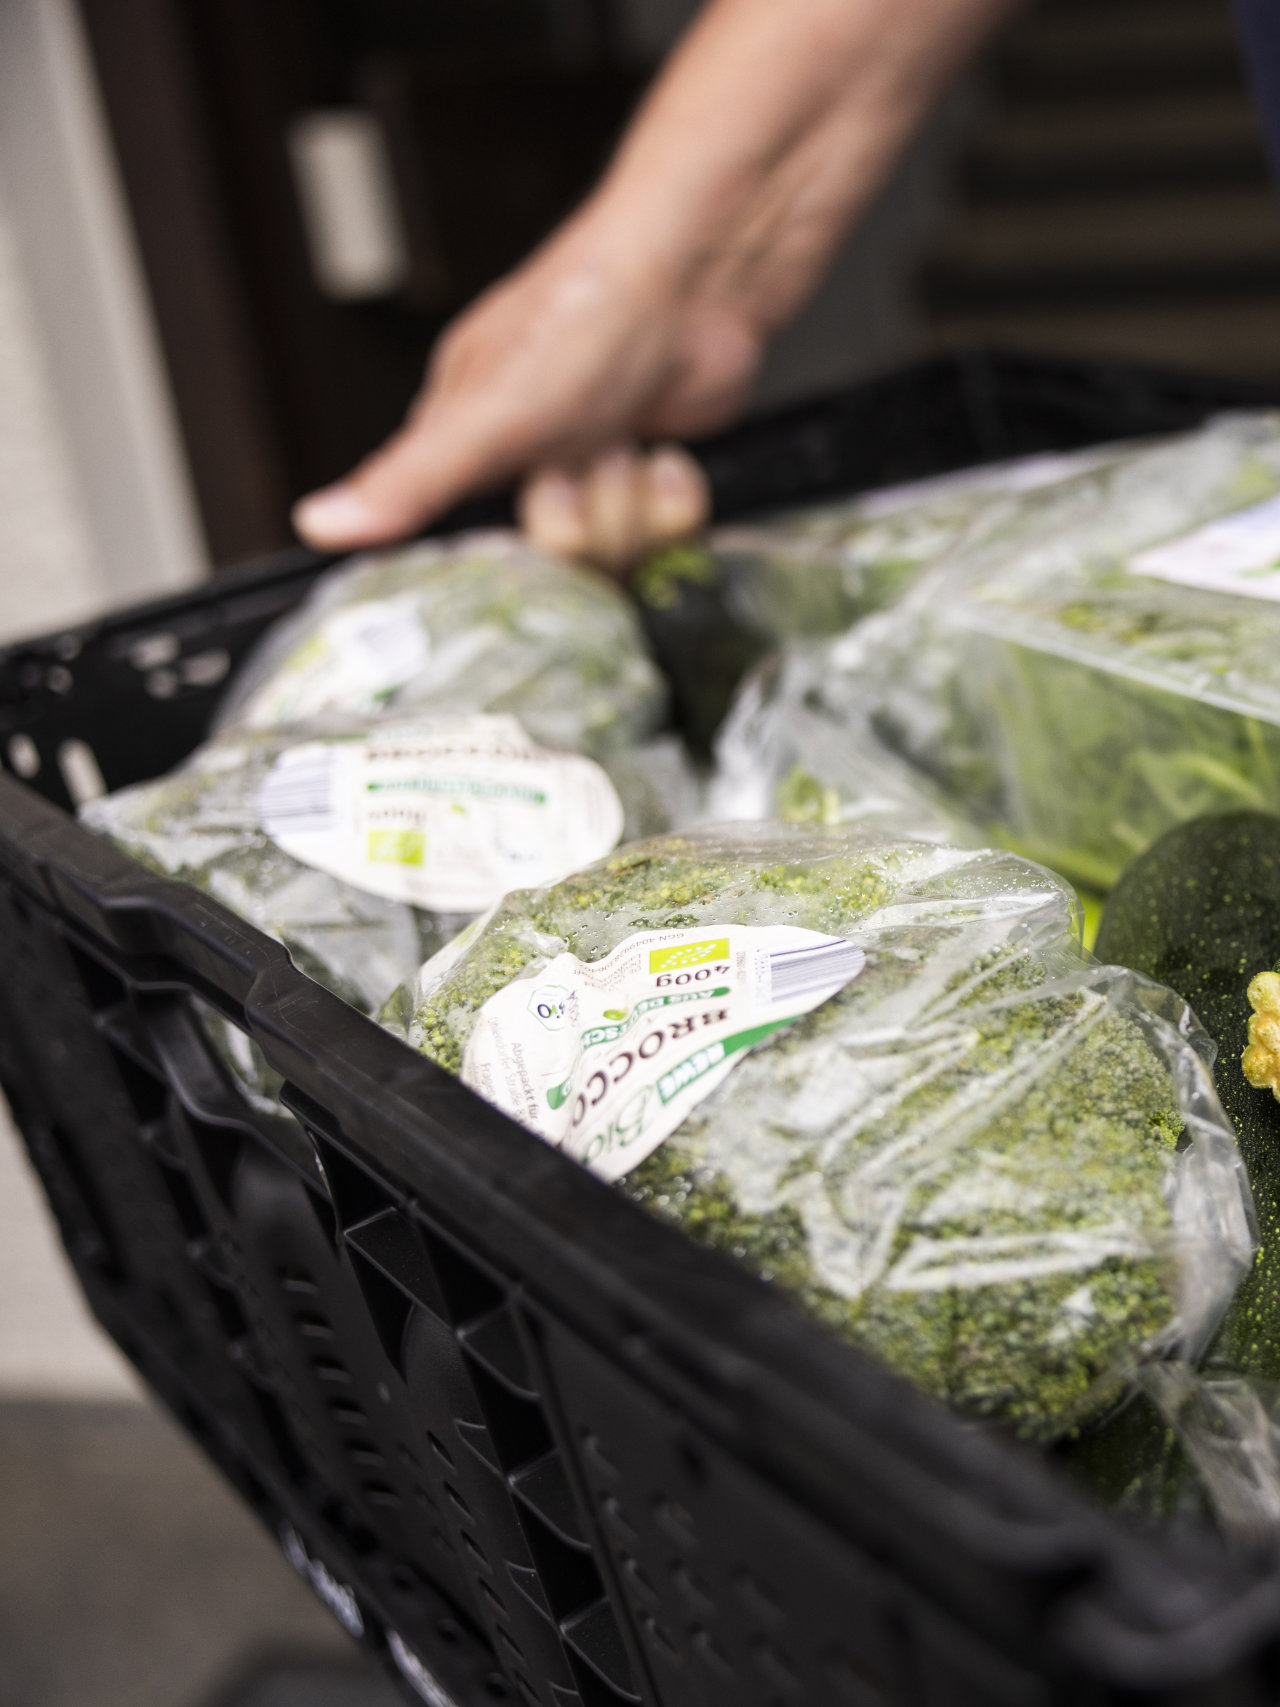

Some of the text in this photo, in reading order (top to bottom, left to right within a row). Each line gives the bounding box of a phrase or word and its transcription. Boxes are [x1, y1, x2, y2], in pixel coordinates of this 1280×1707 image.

[656, 965, 731, 988] 400g
[668, 988, 715, 1005] AUS
[511, 1042, 535, 1101] Abgepackt
[658, 1041, 726, 1103] REWE
[581, 1083, 655, 1166] Bio
